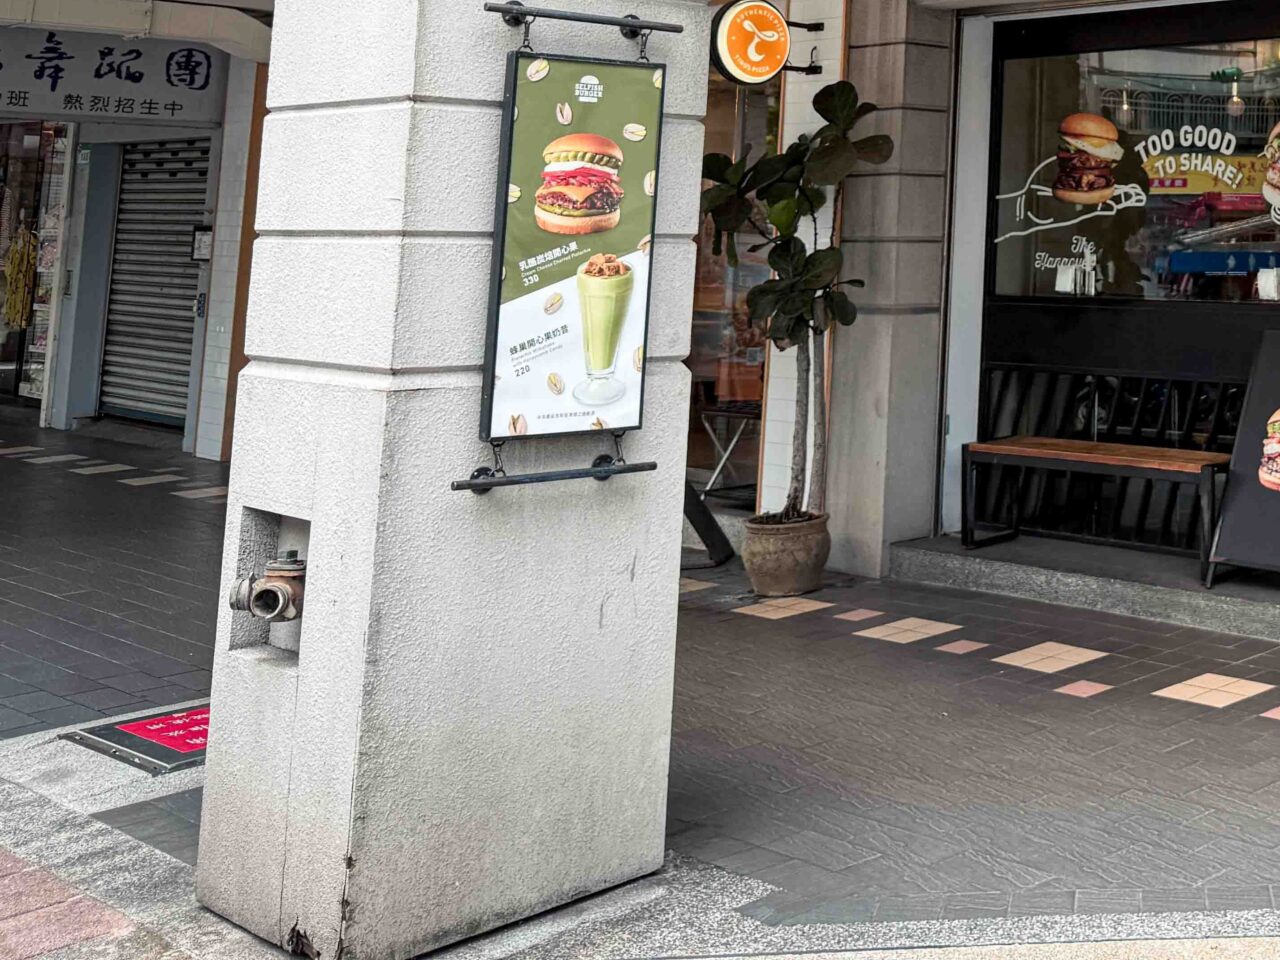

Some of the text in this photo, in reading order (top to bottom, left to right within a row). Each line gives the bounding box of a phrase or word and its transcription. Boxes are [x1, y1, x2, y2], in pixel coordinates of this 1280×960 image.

[0, 31, 212, 91] 舞蹈團
[0, 91, 184, 118] 班 熱烈招生中
[1134, 124, 1238, 164] TOO GOOD
[1154, 156, 1177, 178] TO
[1179, 152, 1244, 190] SHARE!
[1071, 234, 1097, 254] The
[522, 274, 539, 287] 330
[514, 364, 531, 377] 220
